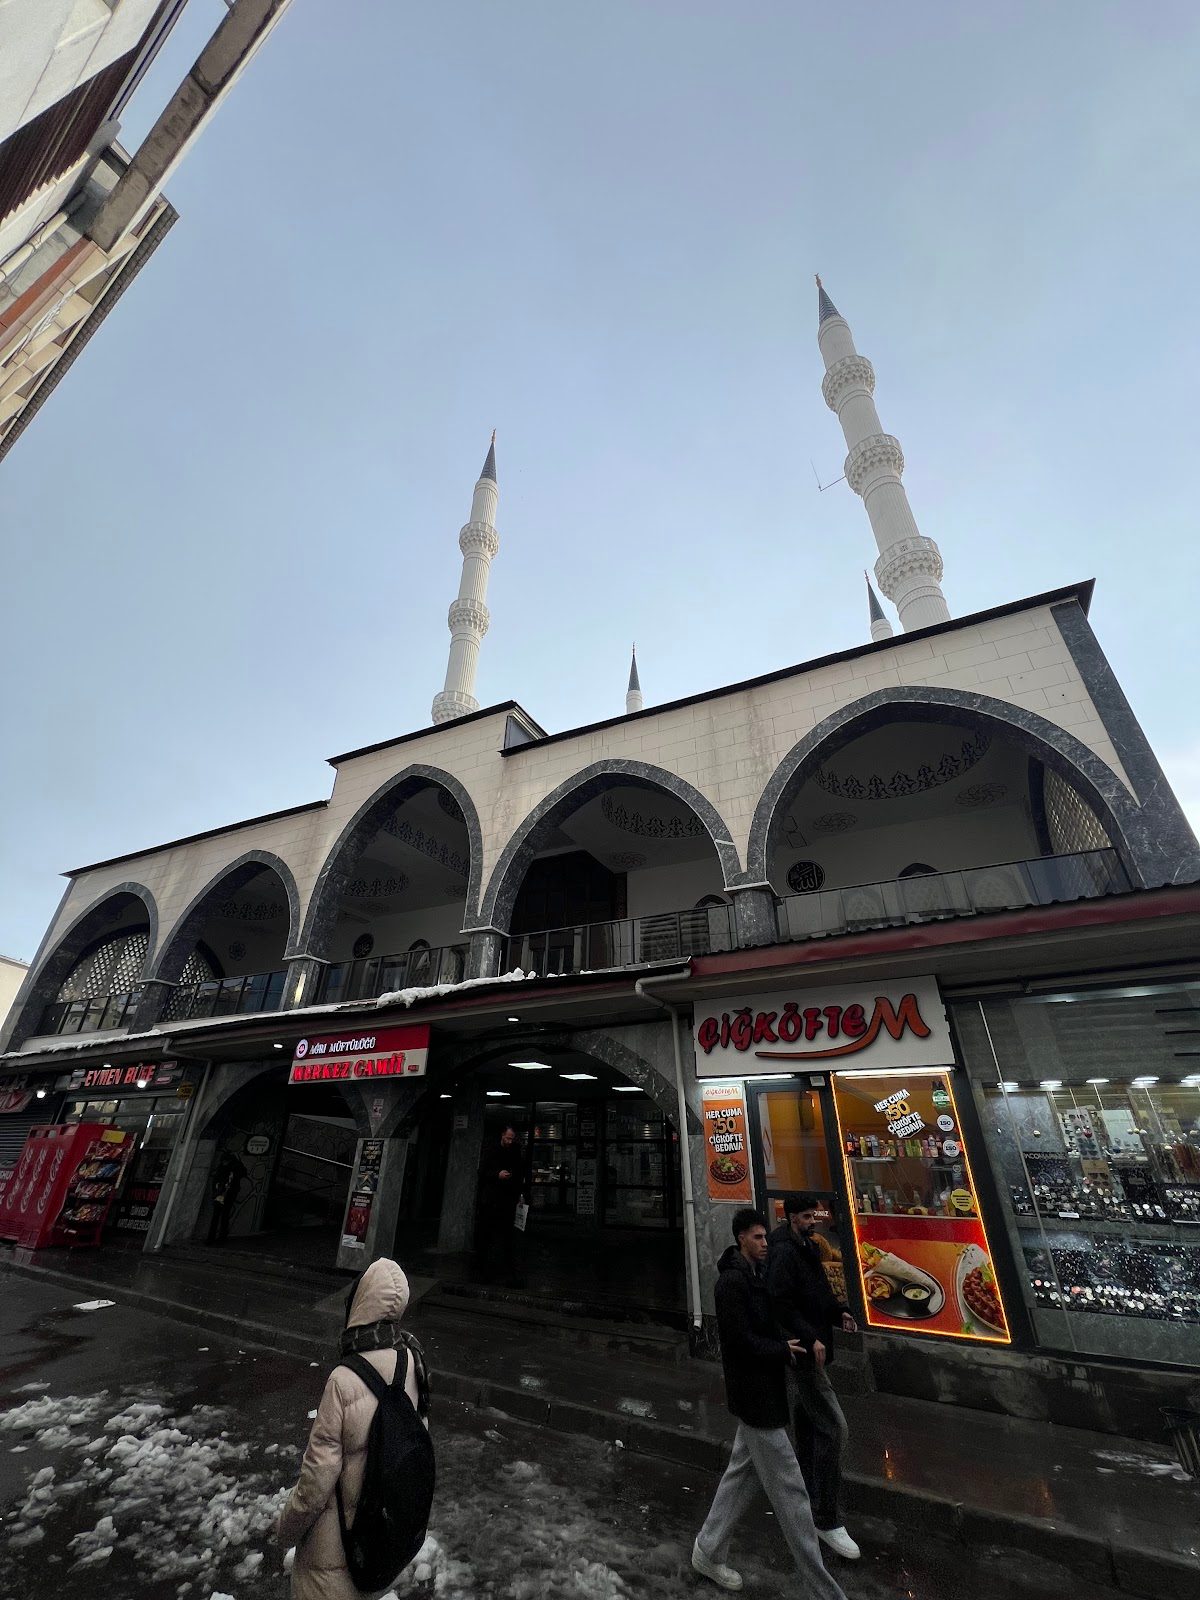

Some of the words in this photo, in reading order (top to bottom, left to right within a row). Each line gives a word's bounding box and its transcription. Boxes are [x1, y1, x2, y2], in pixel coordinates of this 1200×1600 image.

[292, 1061, 351, 1082] MERKEZ
[354, 1052, 405, 1078] CAMİİ
[84, 1068, 123, 1087] EYMEN
[873, 1097, 889, 1113] HER
[887, 1088, 910, 1105] CUMA
[705, 1110, 720, 1119] HER
[720, 1107, 742, 1118] CUMA
[895, 1119, 926, 1139] BEDAVA
[715, 1141, 743, 1153] BEDAVA
